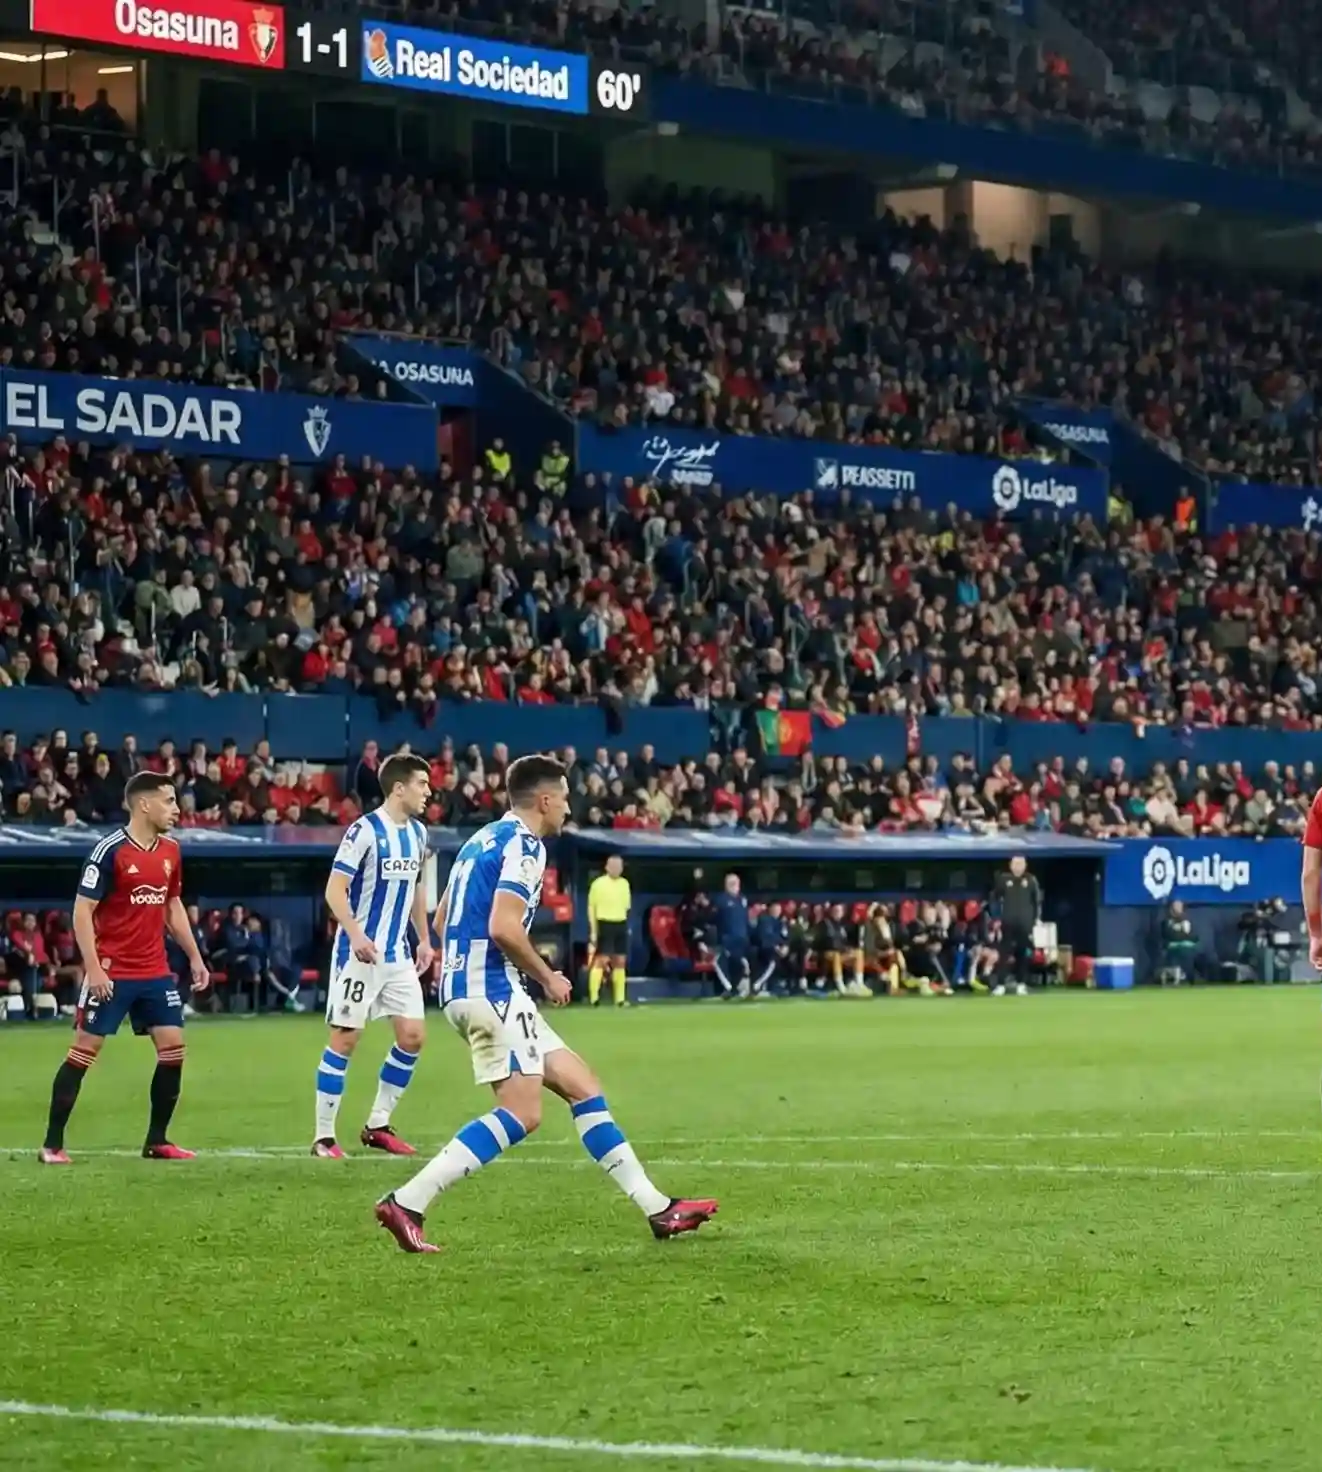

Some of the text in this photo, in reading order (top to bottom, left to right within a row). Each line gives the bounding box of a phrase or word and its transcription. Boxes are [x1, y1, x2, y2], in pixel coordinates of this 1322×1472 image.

[115, 0, 238, 50] Osasuna
[296, 21, 347, 68] 1-1
[396, 40, 568, 100] Real Sociedad
[597, 70, 641, 111] 60'
[395, 361, 474, 387] OSASUNA
[6, 382, 241, 444] EL SADAR
[1023, 478, 1077, 508] LaLiga
[1176, 852, 1250, 892] LaLiga
[342, 977, 365, 1004] 18
